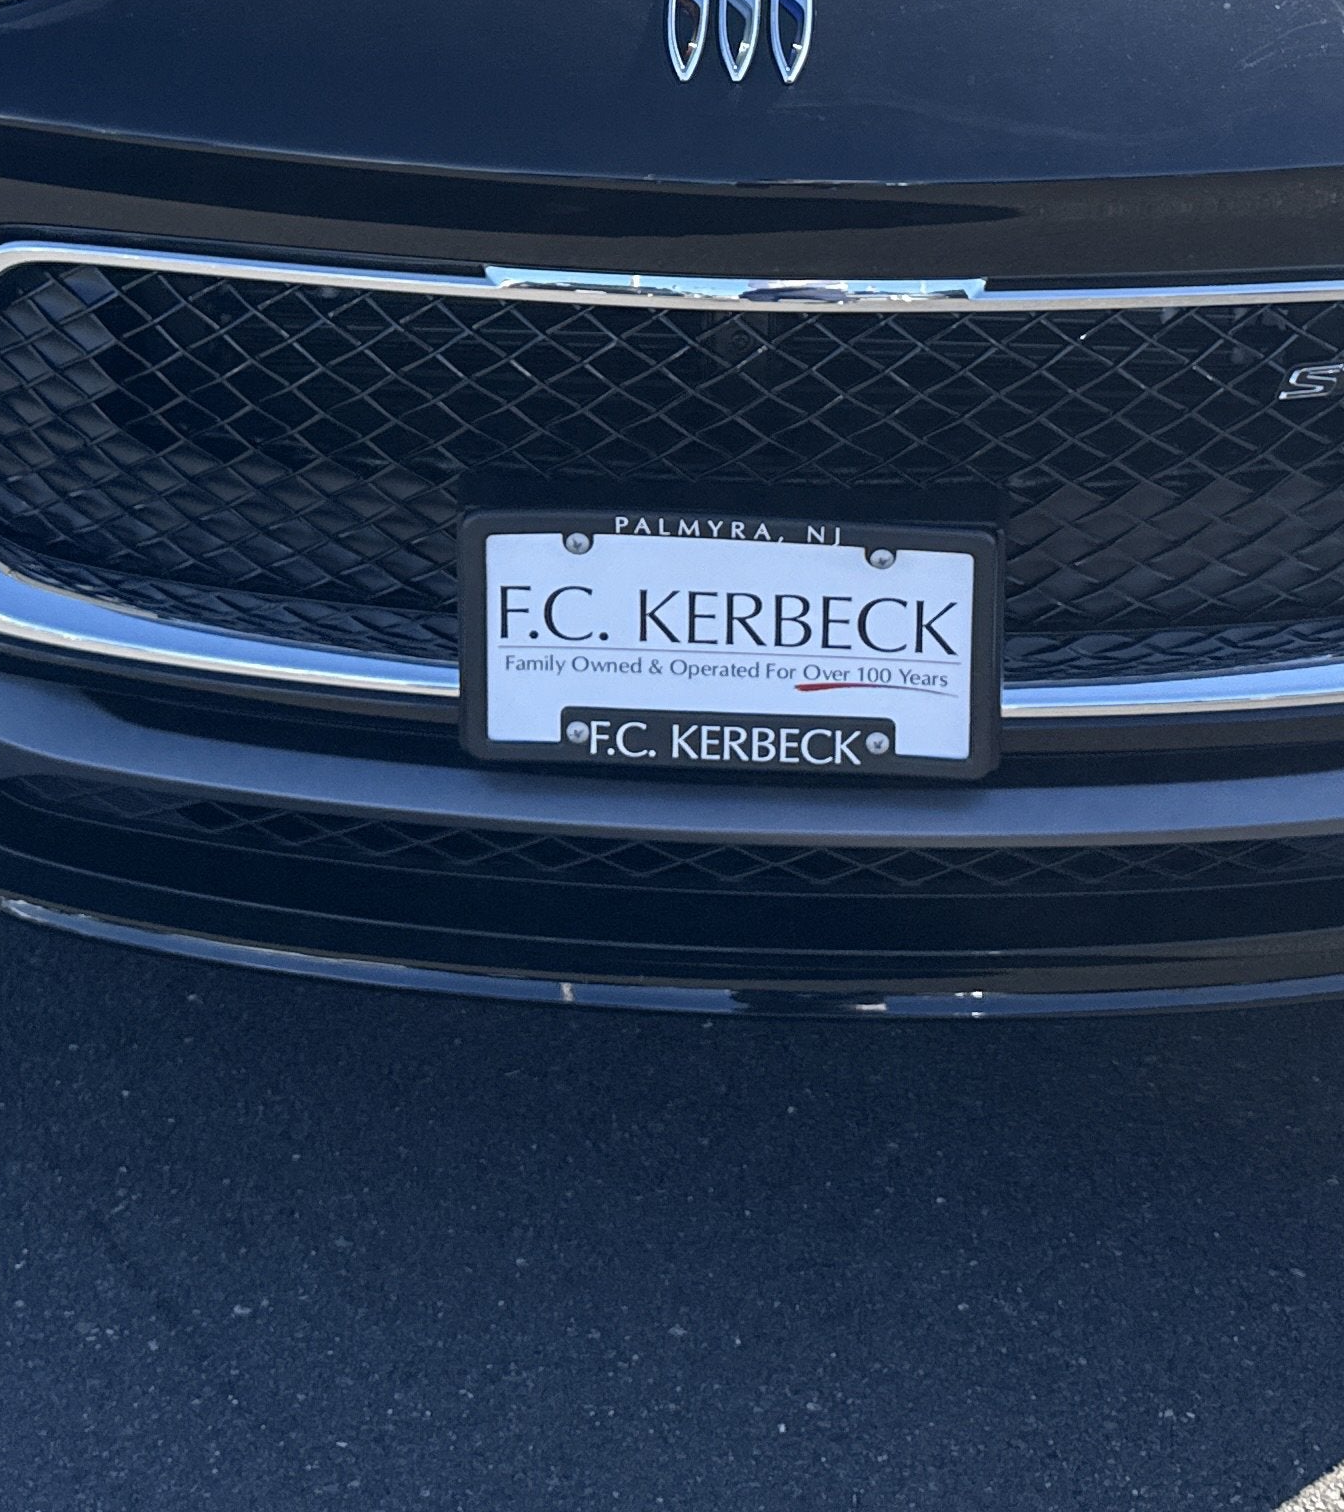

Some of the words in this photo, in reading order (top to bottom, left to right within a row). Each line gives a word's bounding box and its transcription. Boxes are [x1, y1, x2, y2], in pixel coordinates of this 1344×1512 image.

[615, 516, 784, 544] PALMYRA,
[806, 525, 840, 546] NJ
[499, 585, 609, 641] F.C.
[638, 589, 958, 656] KERBECK
[506, 654, 566, 675] Family
[571, 656, 643, 674] Owned
[648, 659, 663, 675] &
[670, 659, 760, 679] Operated
[766, 663, 796, 680] For
[803, 664, 851, 682] Over
[857, 667, 892, 684] 100
[899, 668, 949, 687] Years
[589, 720, 656, 758] F.C.
[670, 724, 862, 766] KERBECK
